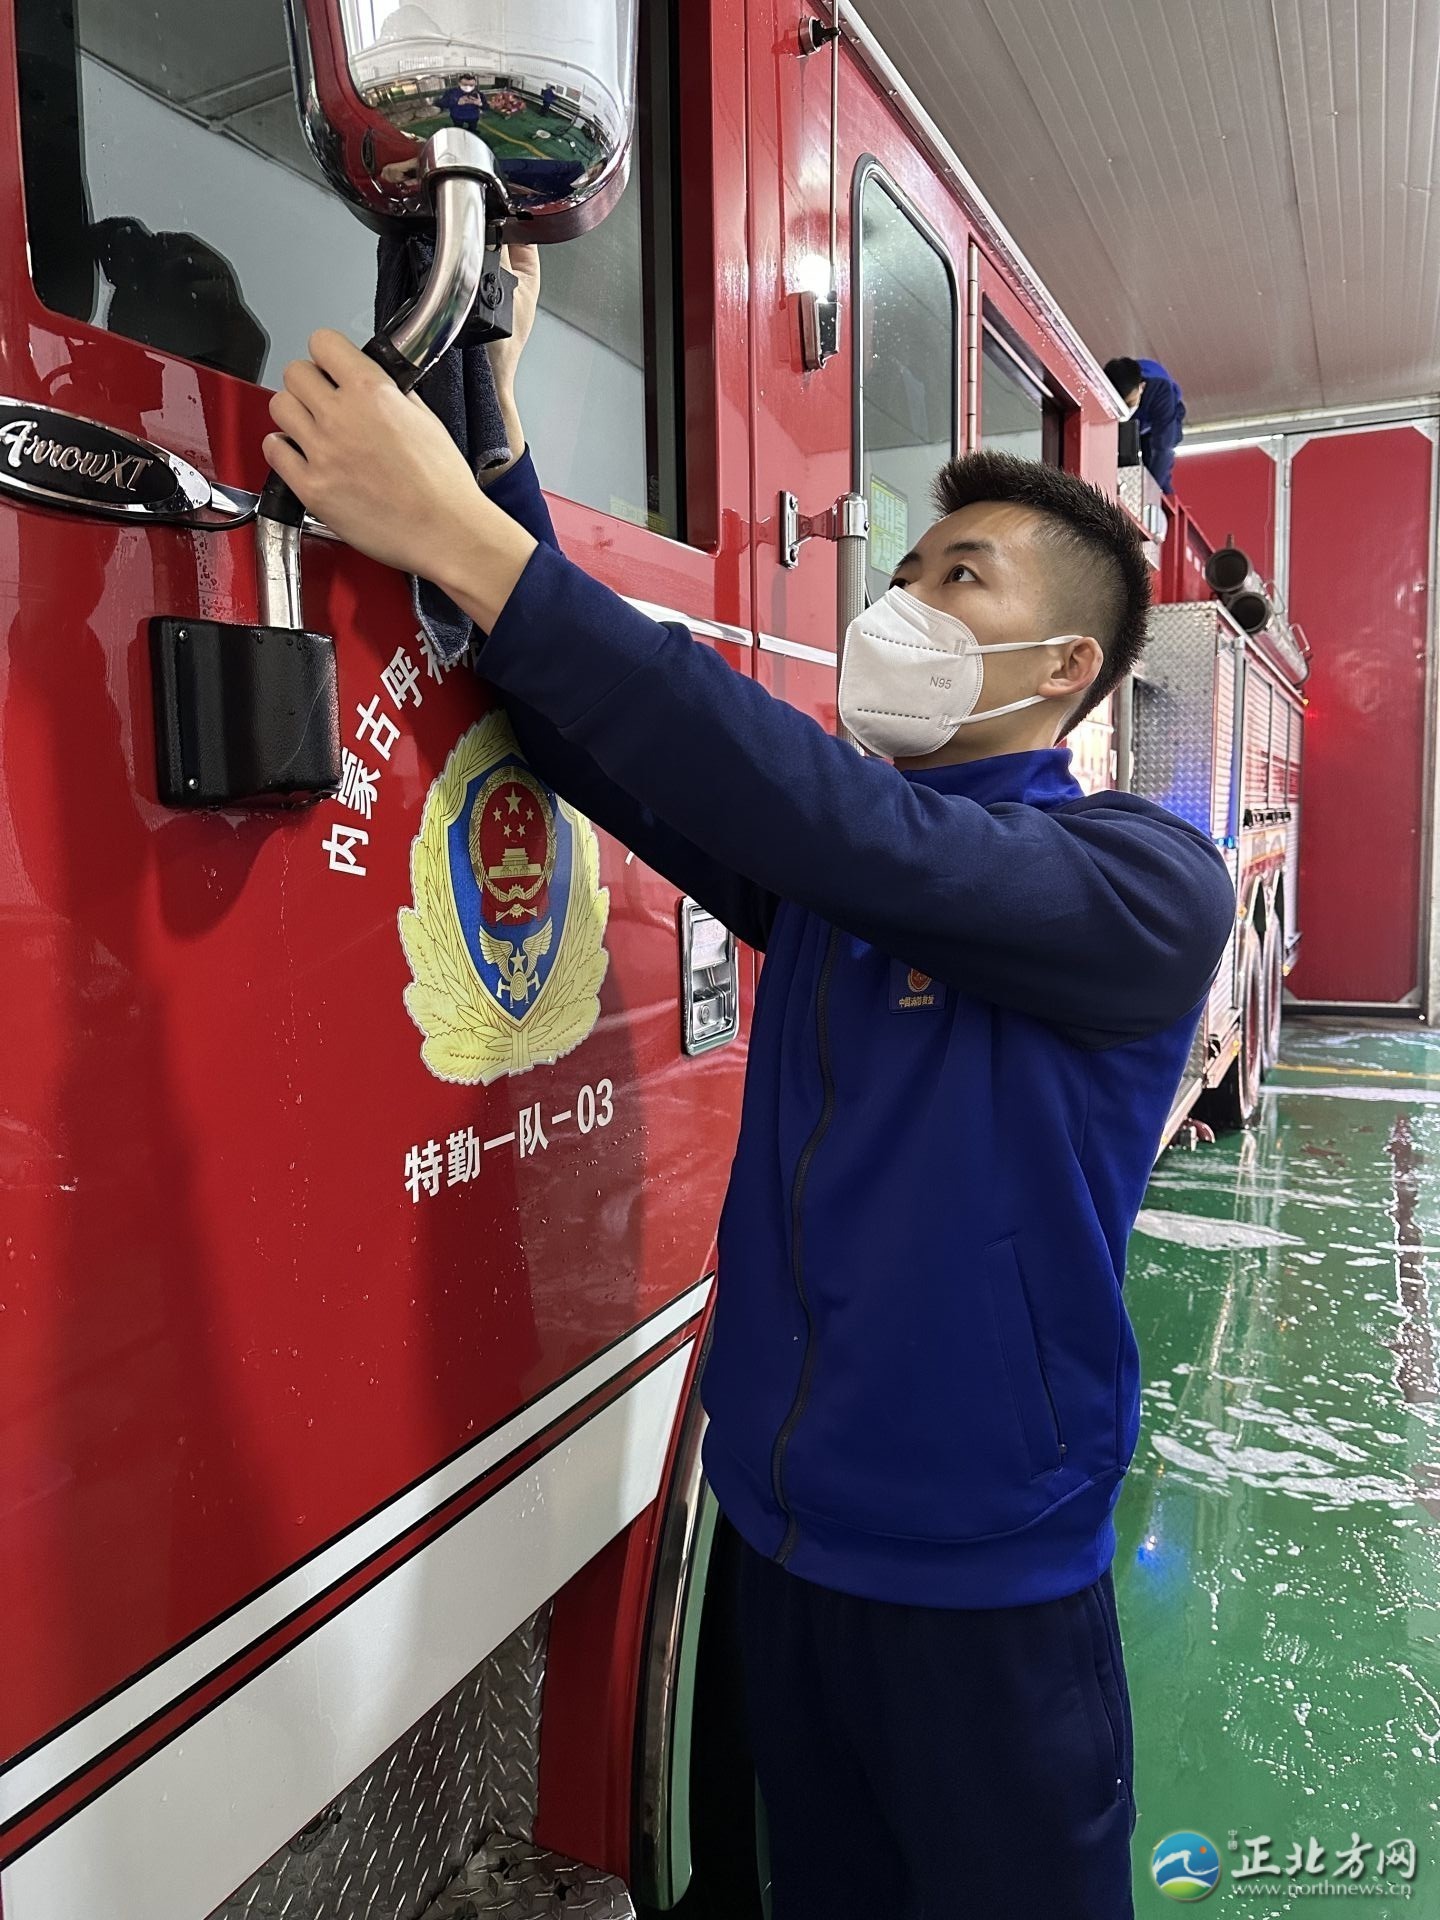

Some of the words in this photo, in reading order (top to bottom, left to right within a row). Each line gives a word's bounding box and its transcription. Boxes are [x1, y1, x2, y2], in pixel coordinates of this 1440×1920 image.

[929, 676, 952, 690] N95
[322, 629, 480, 877] 内蒙古呼
